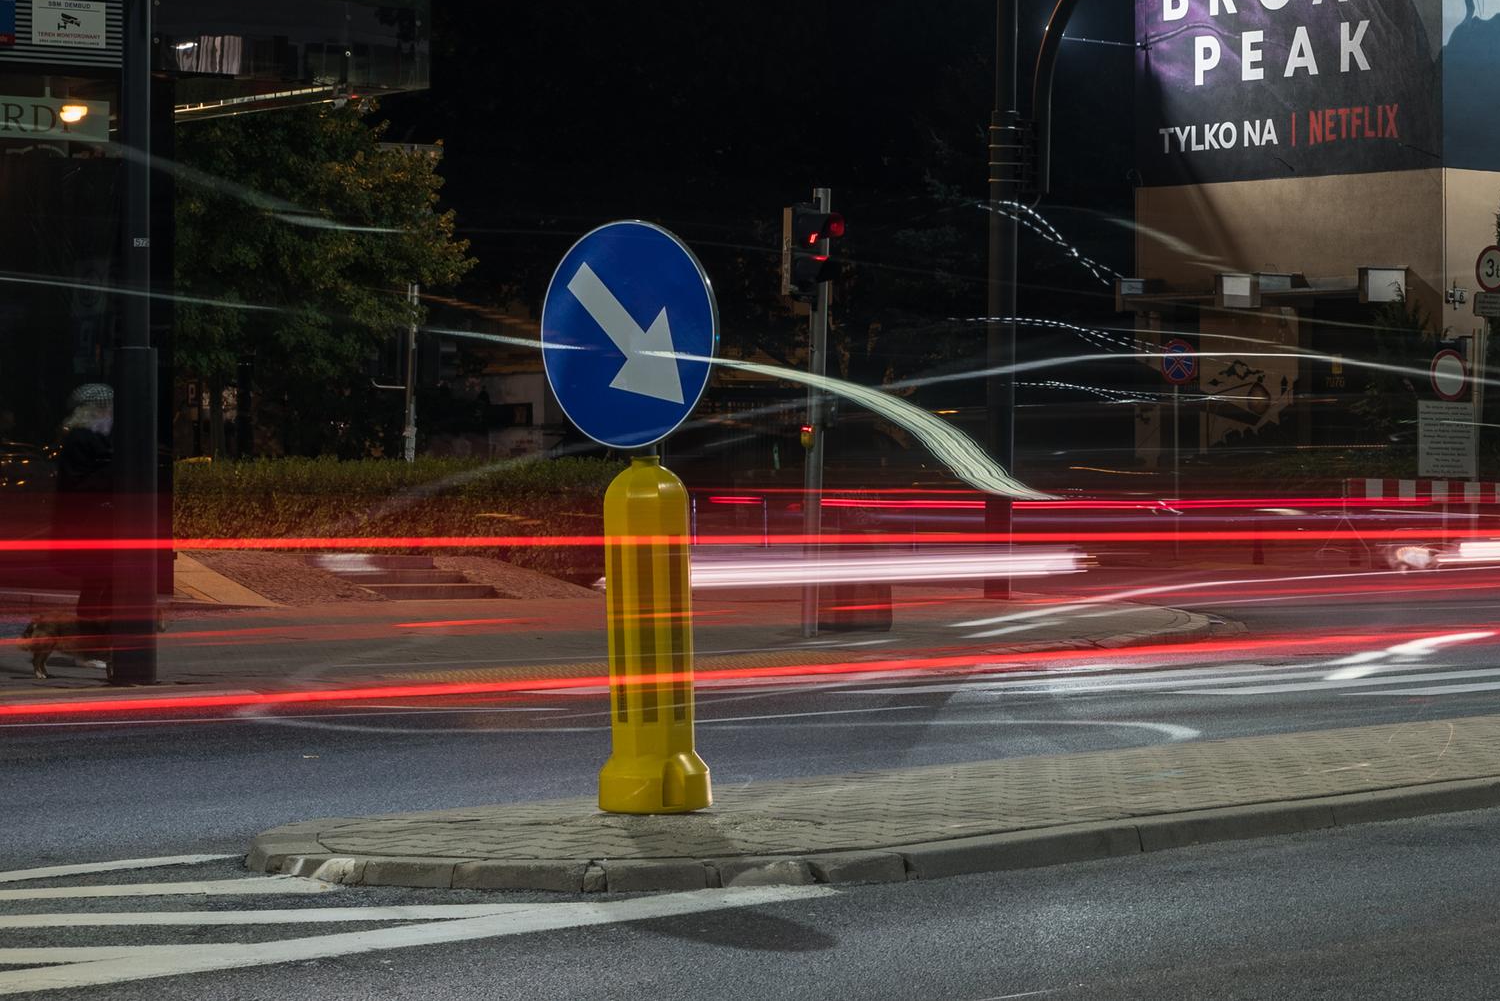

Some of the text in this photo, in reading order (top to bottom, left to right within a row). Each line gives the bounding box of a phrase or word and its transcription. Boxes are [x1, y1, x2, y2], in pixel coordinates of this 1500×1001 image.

[1194, 20, 1371, 86] PEAK
[1159, 103, 1399, 154] TYLKO NA NETFLIX
